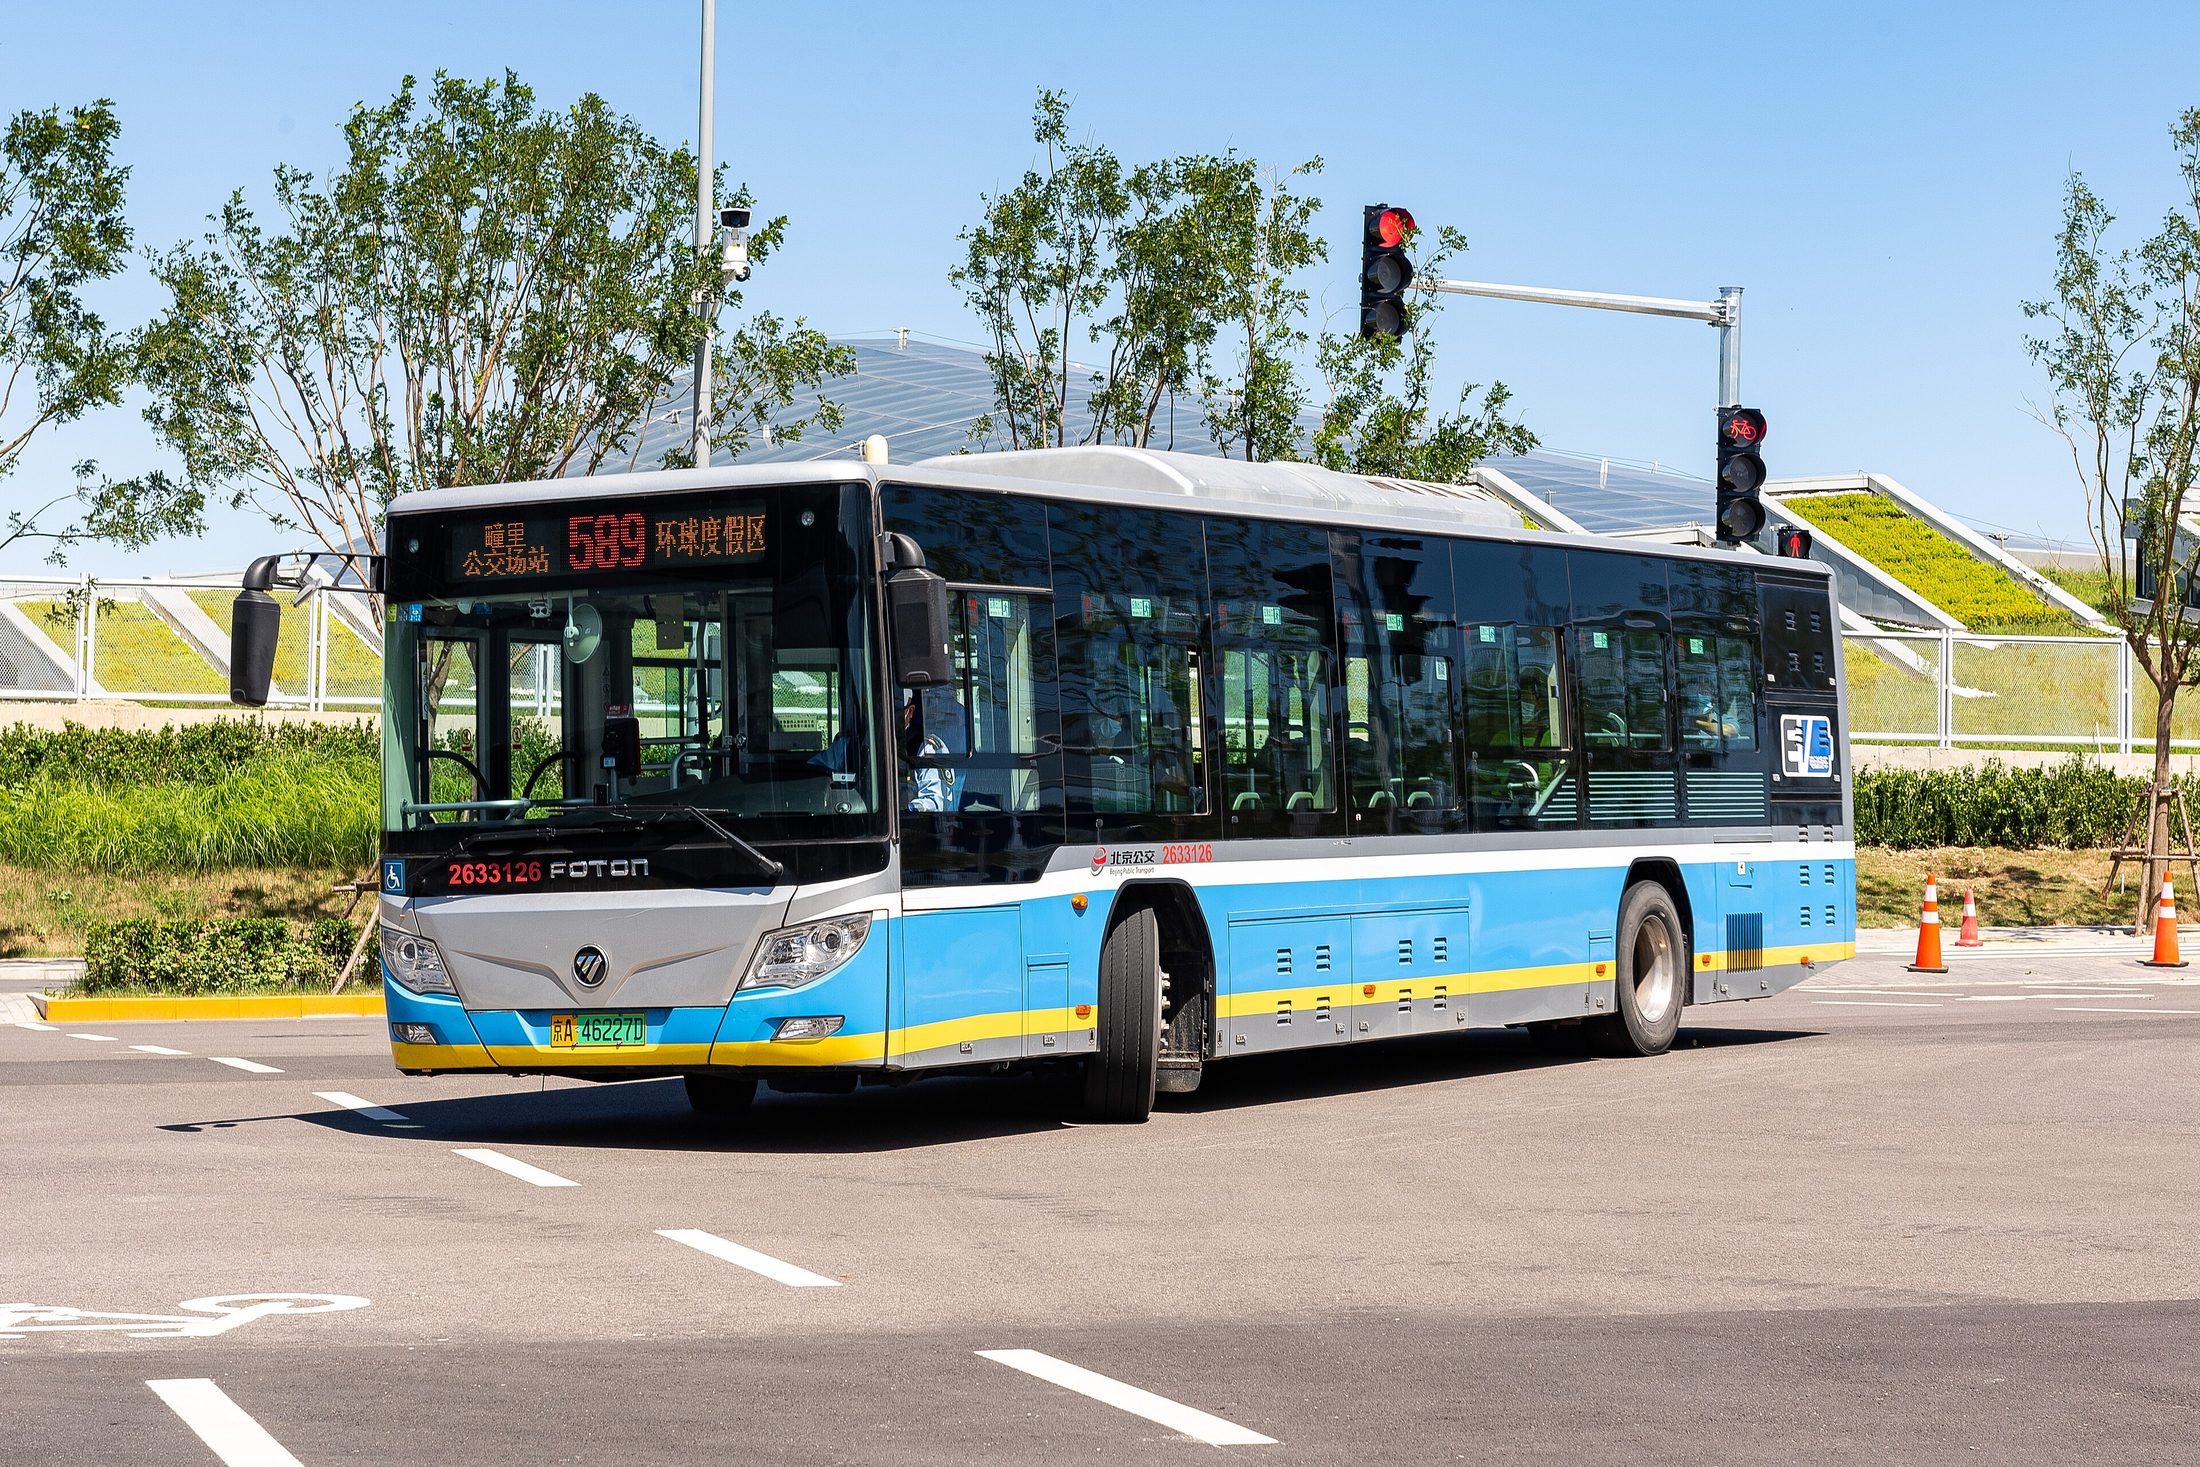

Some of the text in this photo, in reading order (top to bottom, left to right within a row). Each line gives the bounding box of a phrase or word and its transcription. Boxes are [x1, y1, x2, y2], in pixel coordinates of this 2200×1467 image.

[569, 513, 645, 570] 589
[655, 514, 766, 557] 环球度假区
[462, 545, 550, 577] 公交场站
[1110, 850, 1156, 865] 北京公交
[1161, 843, 1213, 865] 2633126
[449, 861, 542, 885] 2633126
[550, 858, 649, 879] FOTON
[1109, 866, 1155, 876] Beijing Public Transport
